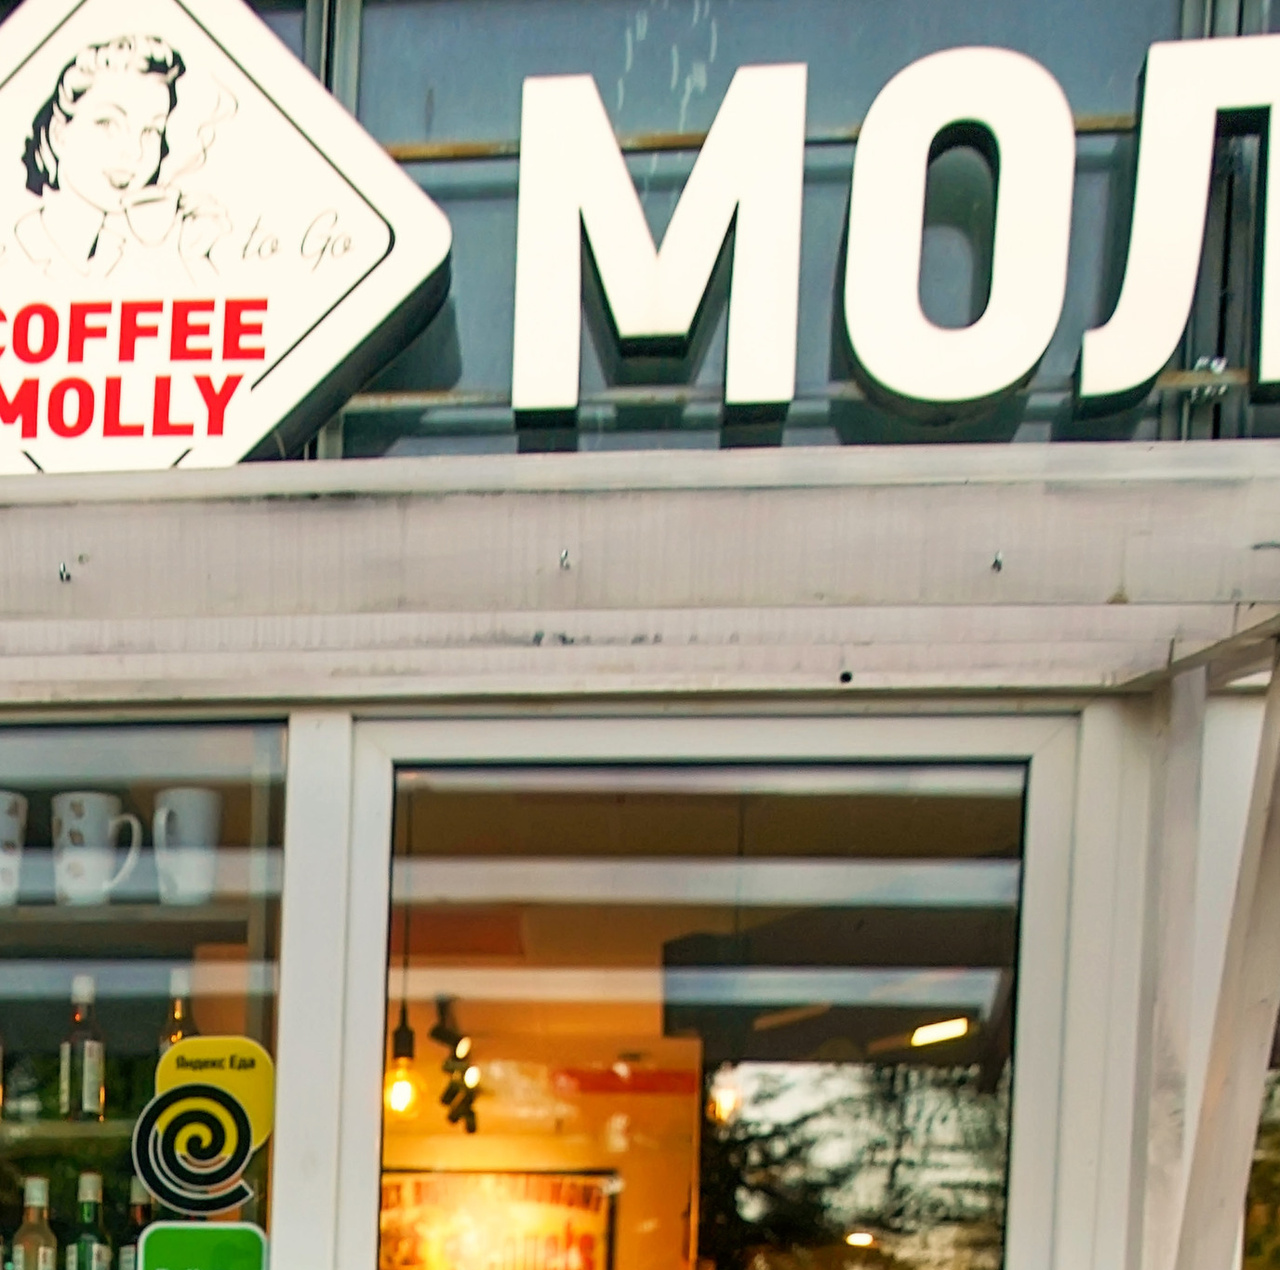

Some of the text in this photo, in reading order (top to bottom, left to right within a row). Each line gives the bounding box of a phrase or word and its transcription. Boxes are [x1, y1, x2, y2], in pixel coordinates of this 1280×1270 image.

[242, 215, 278, 260] to
[299, 210, 354, 272] Go
[512, 35, 1280, 410] МОЛ
[176, 1054, 256, 1070] Яндекс Еда
